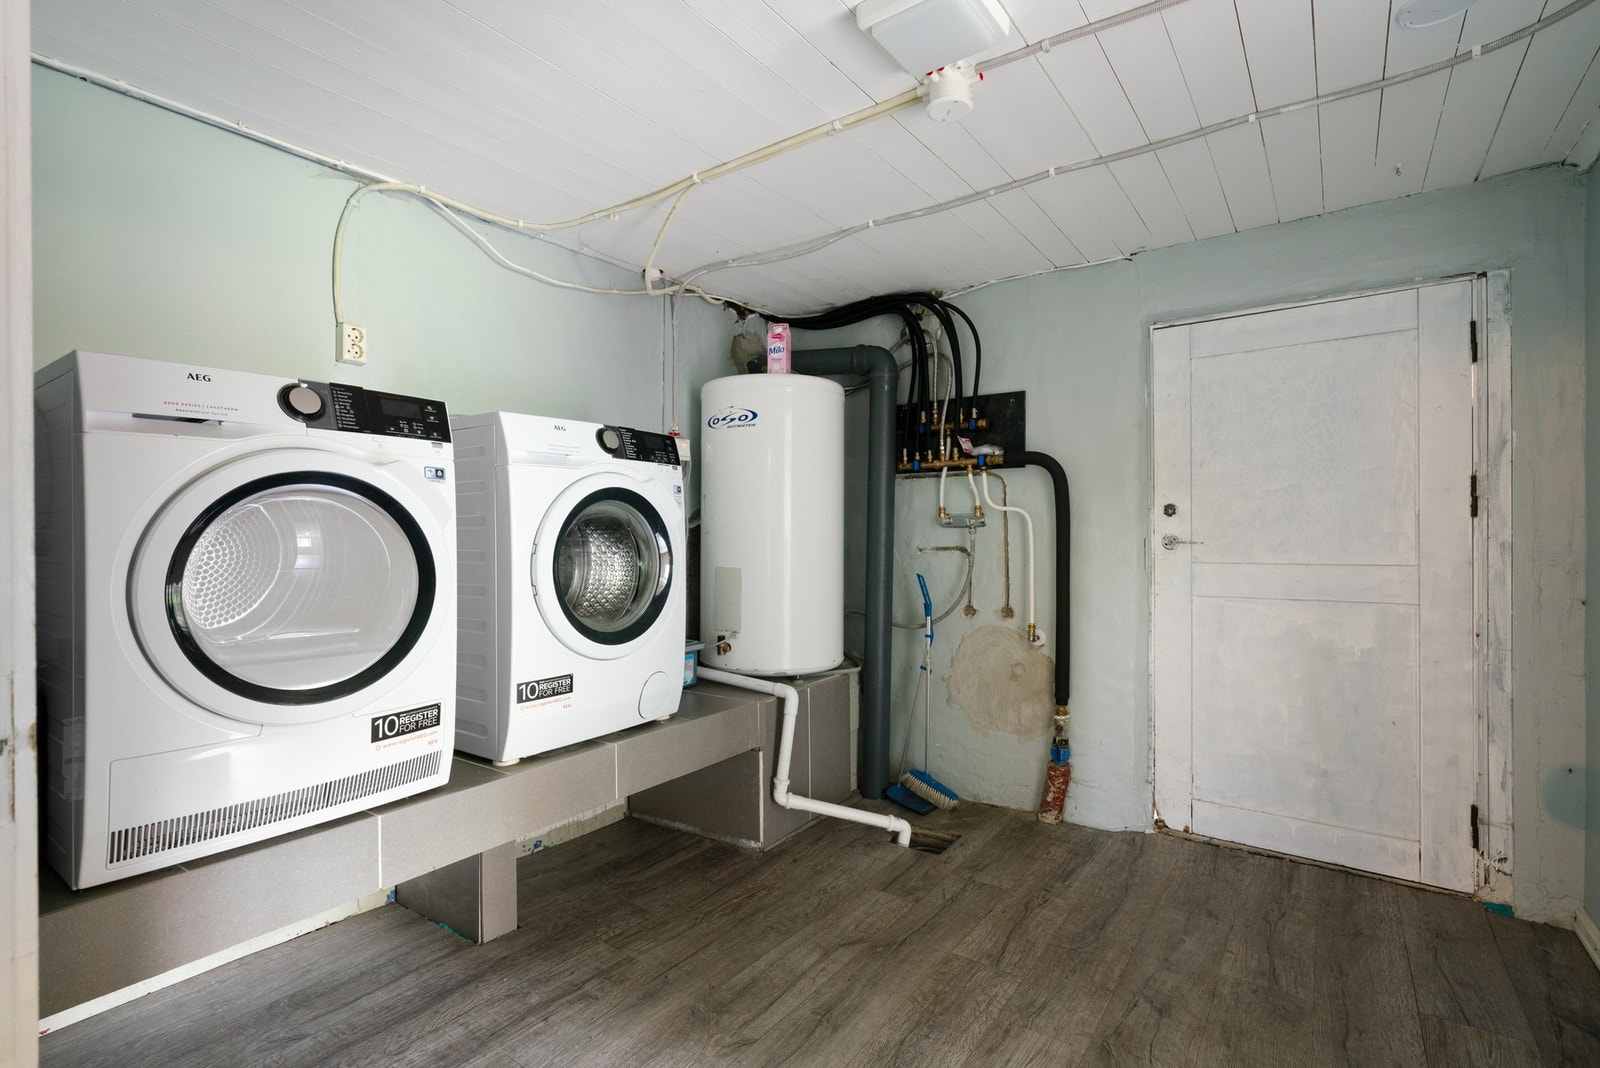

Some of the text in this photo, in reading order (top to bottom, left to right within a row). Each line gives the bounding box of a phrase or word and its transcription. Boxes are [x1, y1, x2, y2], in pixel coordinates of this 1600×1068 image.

[768, 345, 785, 355] Milo
[186, 372, 212, 382] AEG
[519, 682, 539, 701] 10
[539, 678, 571, 691] REGISTER
[539, 685, 571, 698] FOR FREE
[399, 708, 439, 725] REGISTER
[374, 715, 399, 739] 10
[399, 716, 438, 734] FOR FREE
